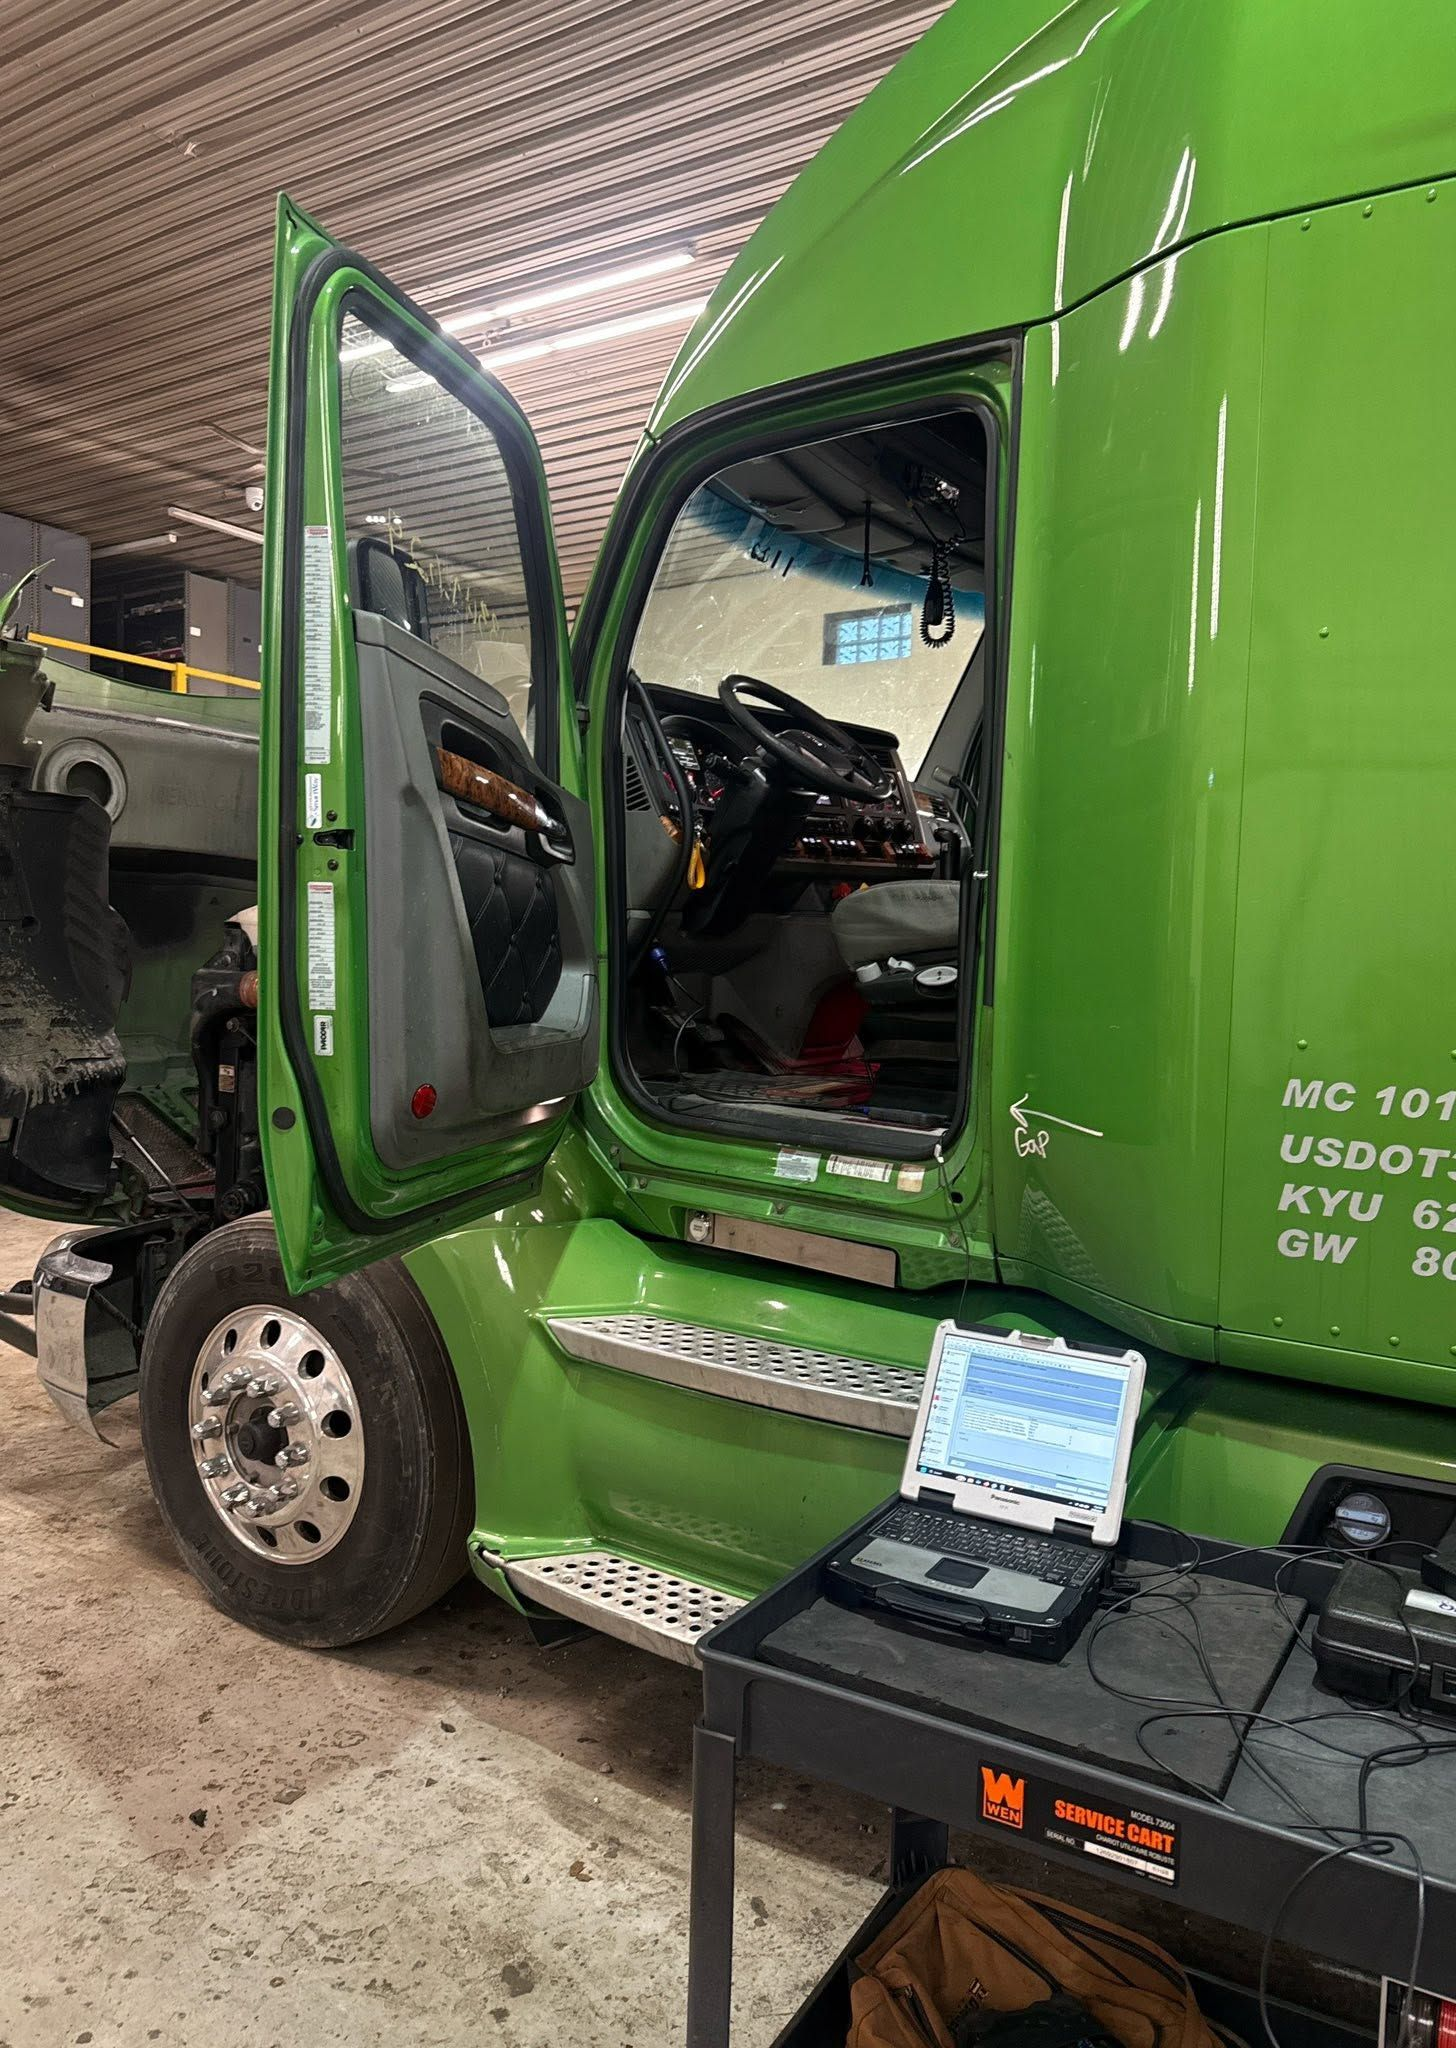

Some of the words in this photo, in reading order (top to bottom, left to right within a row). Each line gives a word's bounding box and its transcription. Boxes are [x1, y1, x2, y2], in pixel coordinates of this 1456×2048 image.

[1281, 1078, 1357, 1112] MC
[1279, 1133, 1456, 1182] USDOT
[1276, 1182, 1384, 1222] KYU
[1277, 1228, 1358, 1264] GW
[990, 1492, 1021, 1507] Panasonic
[986, 1802, 1020, 1823] WEN
[1054, 1800, 1125, 1838] SERVICE
[1127, 1823, 1175, 1854] CART
[1130, 1809, 1155, 1825] MODEL
